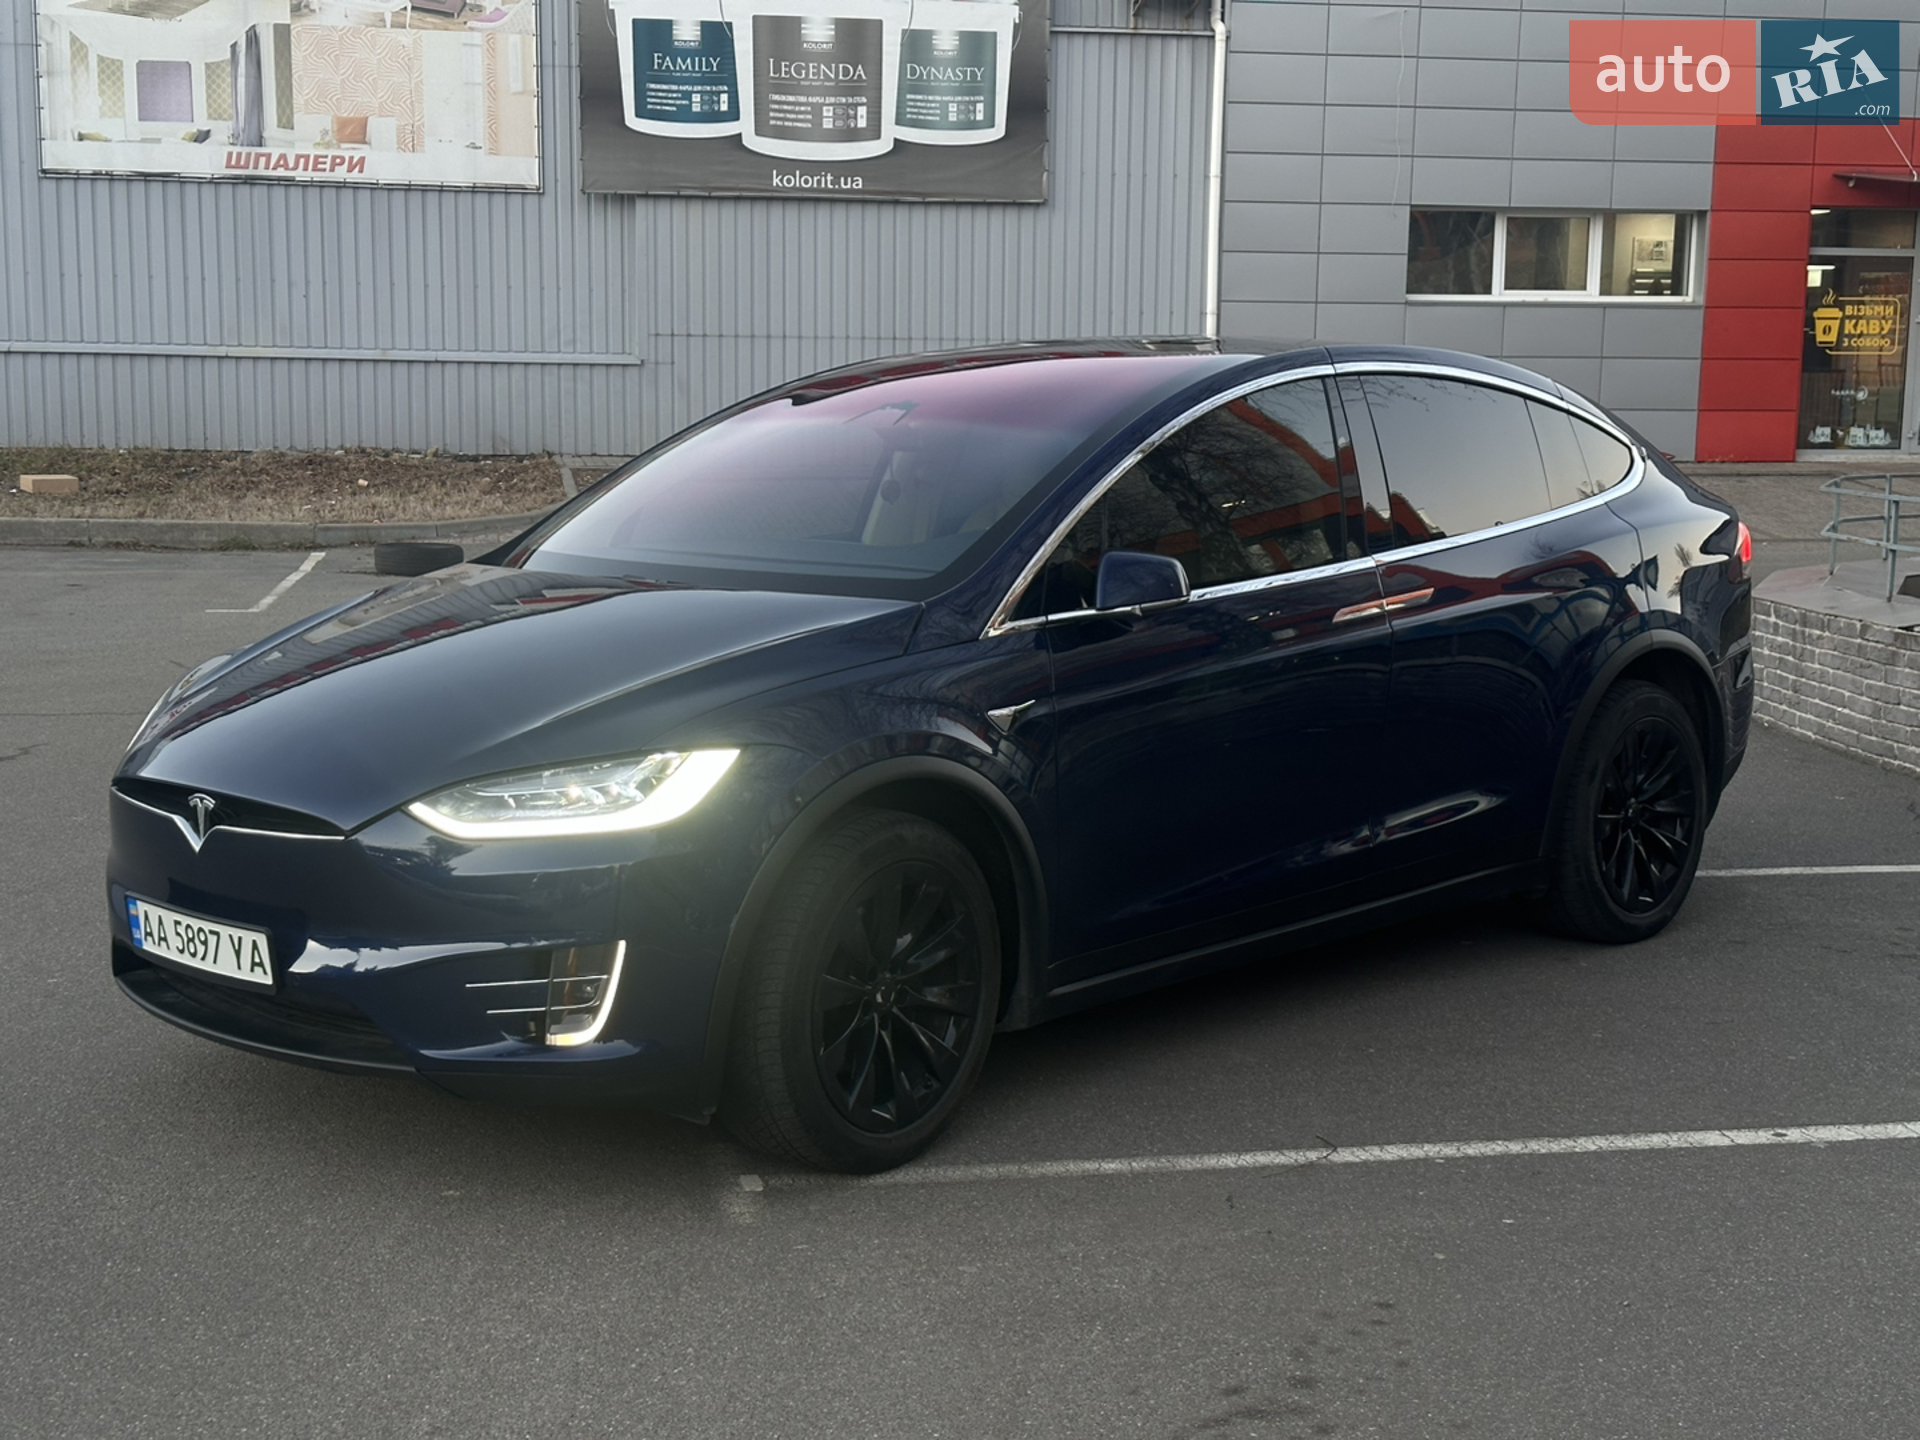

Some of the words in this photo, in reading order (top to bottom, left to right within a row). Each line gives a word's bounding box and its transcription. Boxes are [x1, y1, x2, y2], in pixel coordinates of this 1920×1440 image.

[653, 52, 721, 72] FAMILY
[768, 58, 867, 80] LEGENDA
[906, 63, 985, 81] DYNASTY
[224, 150, 366, 174] ШПАЛЕРИ
[772, 170, 863, 190] kolorit.ua
[1845, 305, 1894, 316] ВІЗЬМИ
[1844, 319, 1893, 334] КАВУ
[1850, 338, 1891, 347] СОБОЮ
[143, 909, 170, 950] AA
[173, 918, 221, 964] 5897
[228, 933, 268, 975] YA
